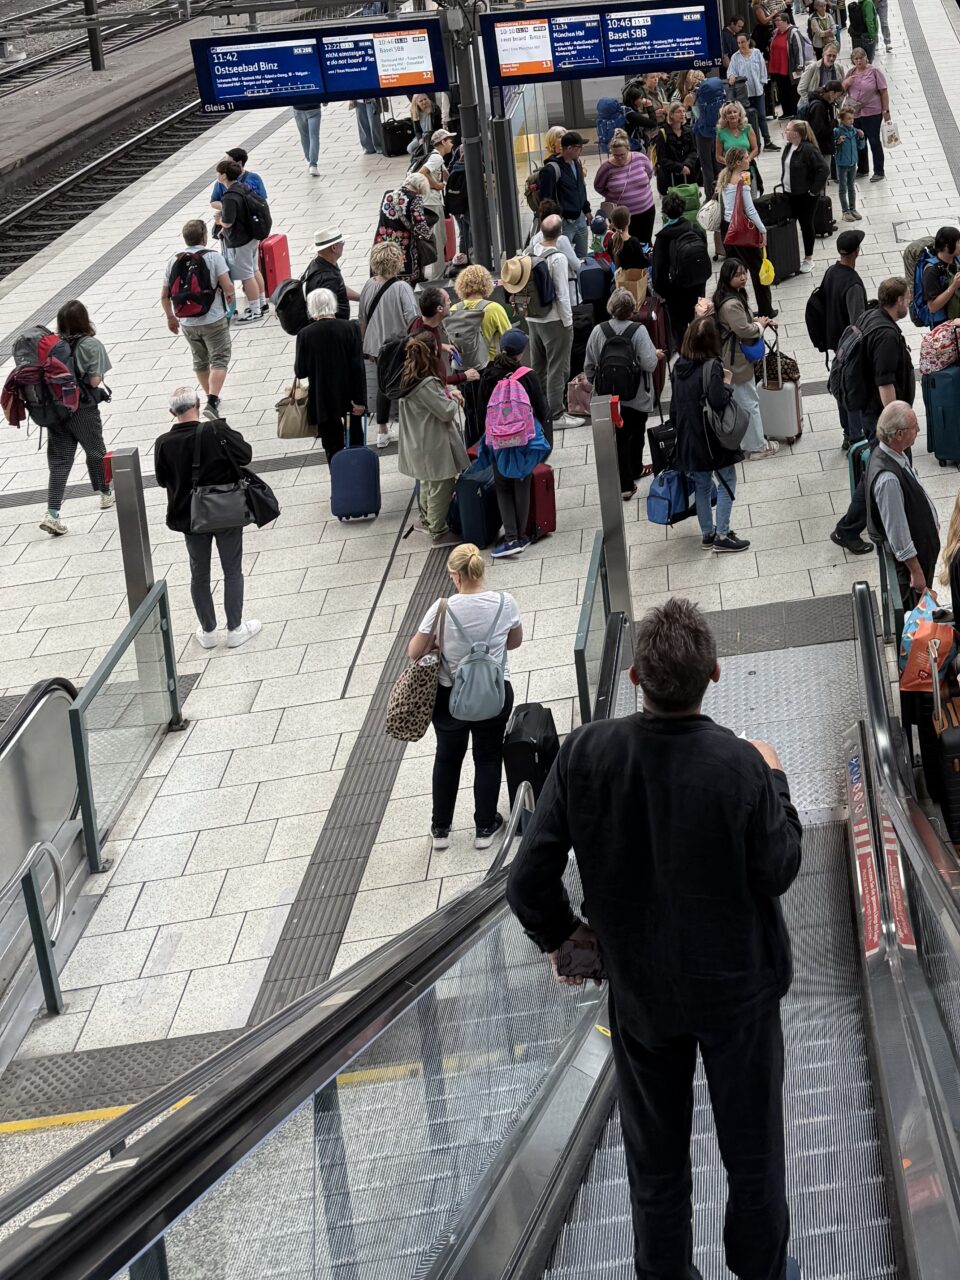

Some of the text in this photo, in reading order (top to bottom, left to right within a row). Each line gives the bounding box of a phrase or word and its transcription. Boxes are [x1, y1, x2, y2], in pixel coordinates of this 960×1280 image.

[607, 19, 631, 29] 10:46
[608, 28, 648, 40] Basel SBB
[213, 52, 238, 63] 11:42
[694, 58, 722, 67] Gleis 12
[214, 61, 279, 75] Ostseebad Binz
[204, 102, 234, 112] Gleis 11
